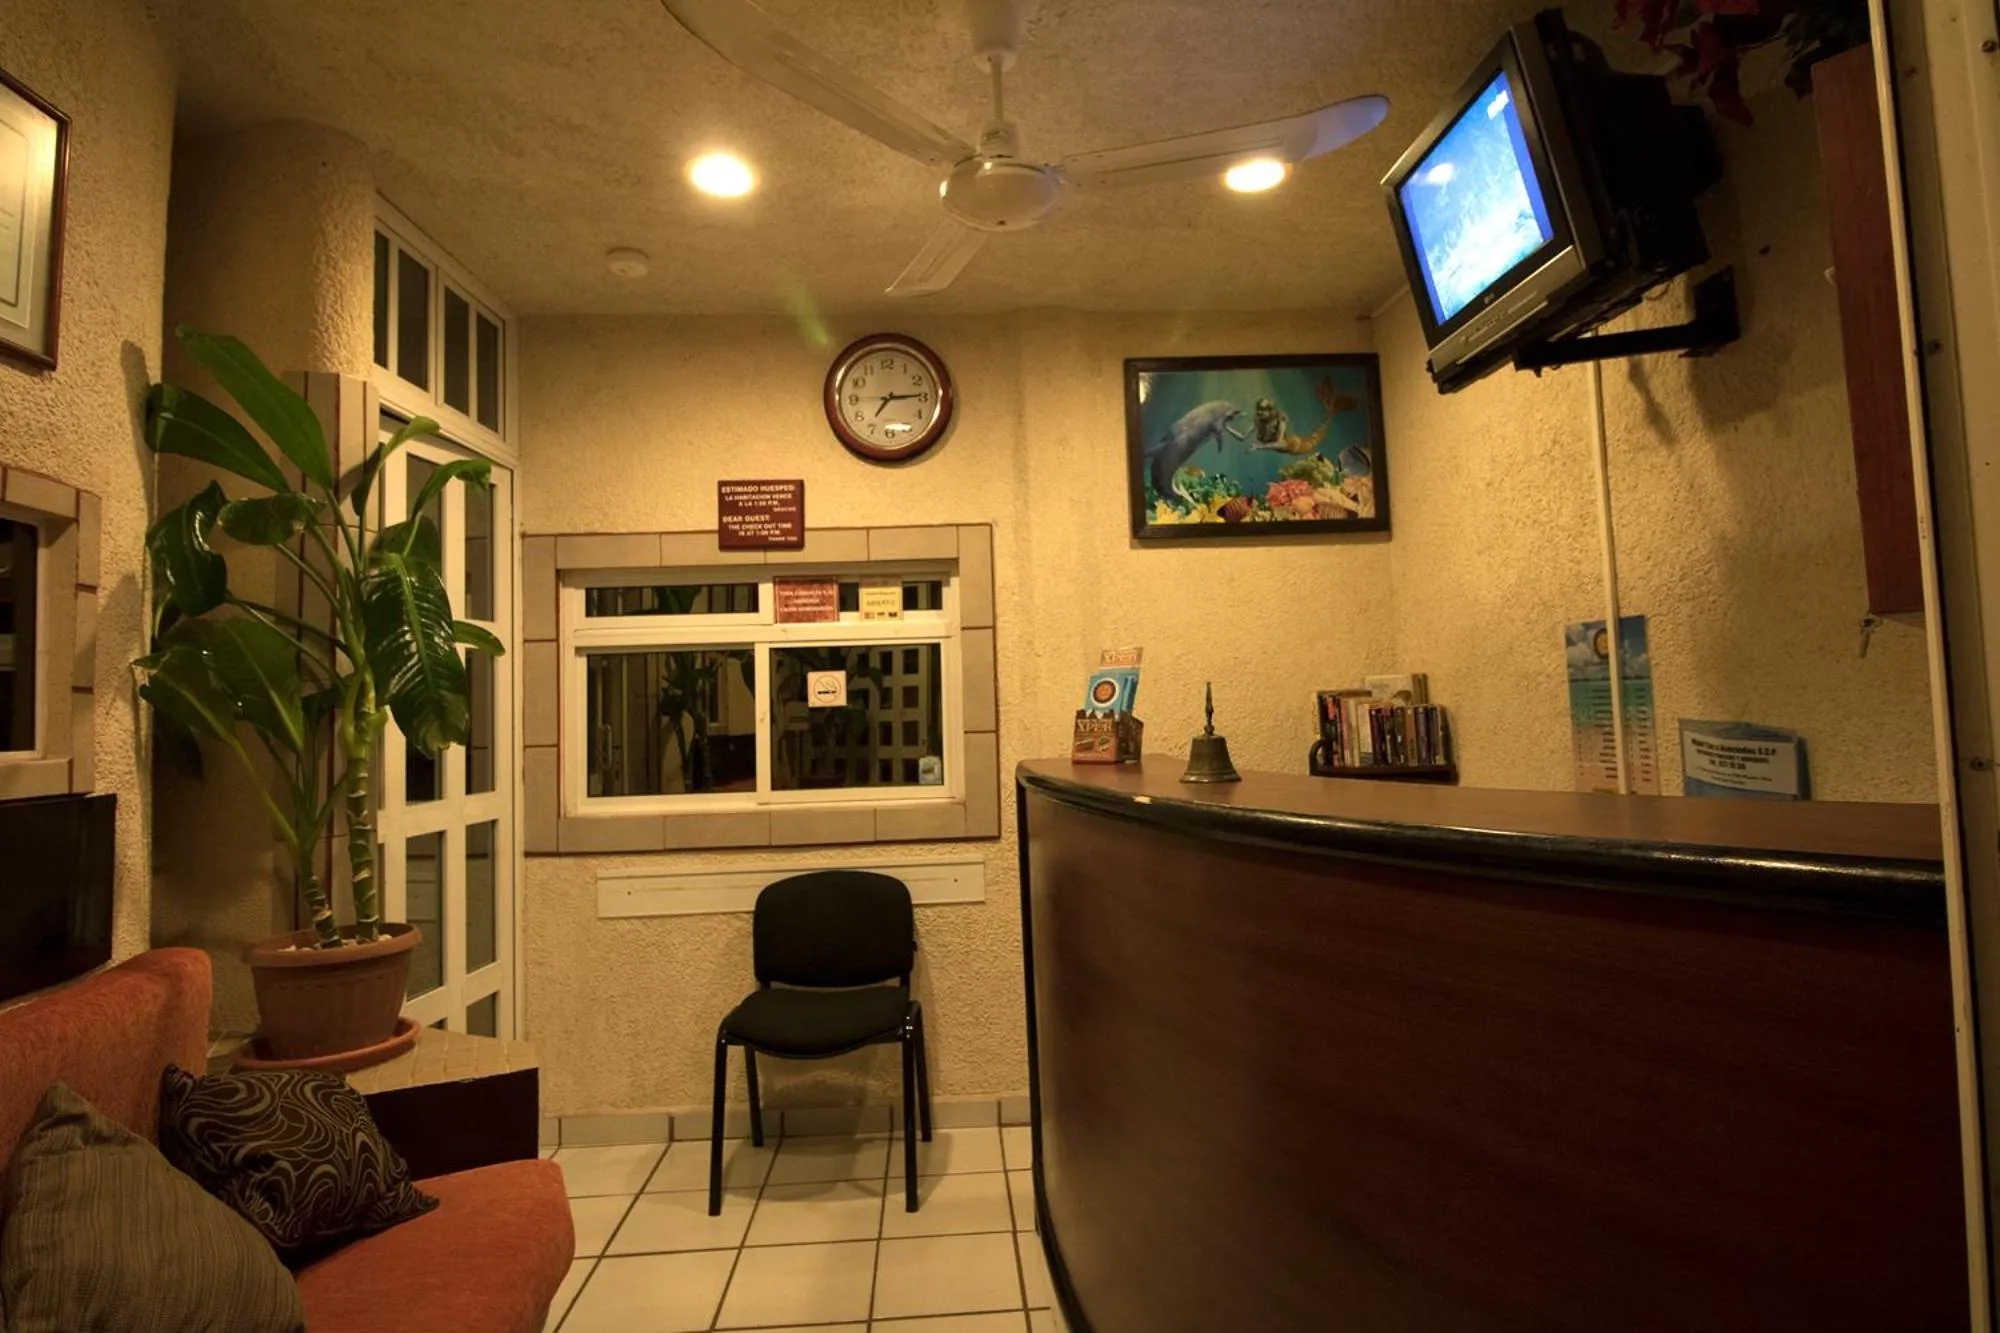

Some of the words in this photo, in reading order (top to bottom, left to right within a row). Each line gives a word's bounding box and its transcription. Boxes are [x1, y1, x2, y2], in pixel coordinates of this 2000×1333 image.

[864, 364, 874, 376] 11
[880, 359, 894, 370] 12
[902, 363, 908, 374] 1
[852, 378, 866, 388] 10
[912, 374, 922, 386] 2
[848, 394, 858, 406] 9
[918, 392, 928, 402] 3
[855, 411, 864, 421] 8
[868, 424, 876, 435] 7
[884, 427, 896, 438] 6
[721, 485, 758, 494] ESTIMADO
